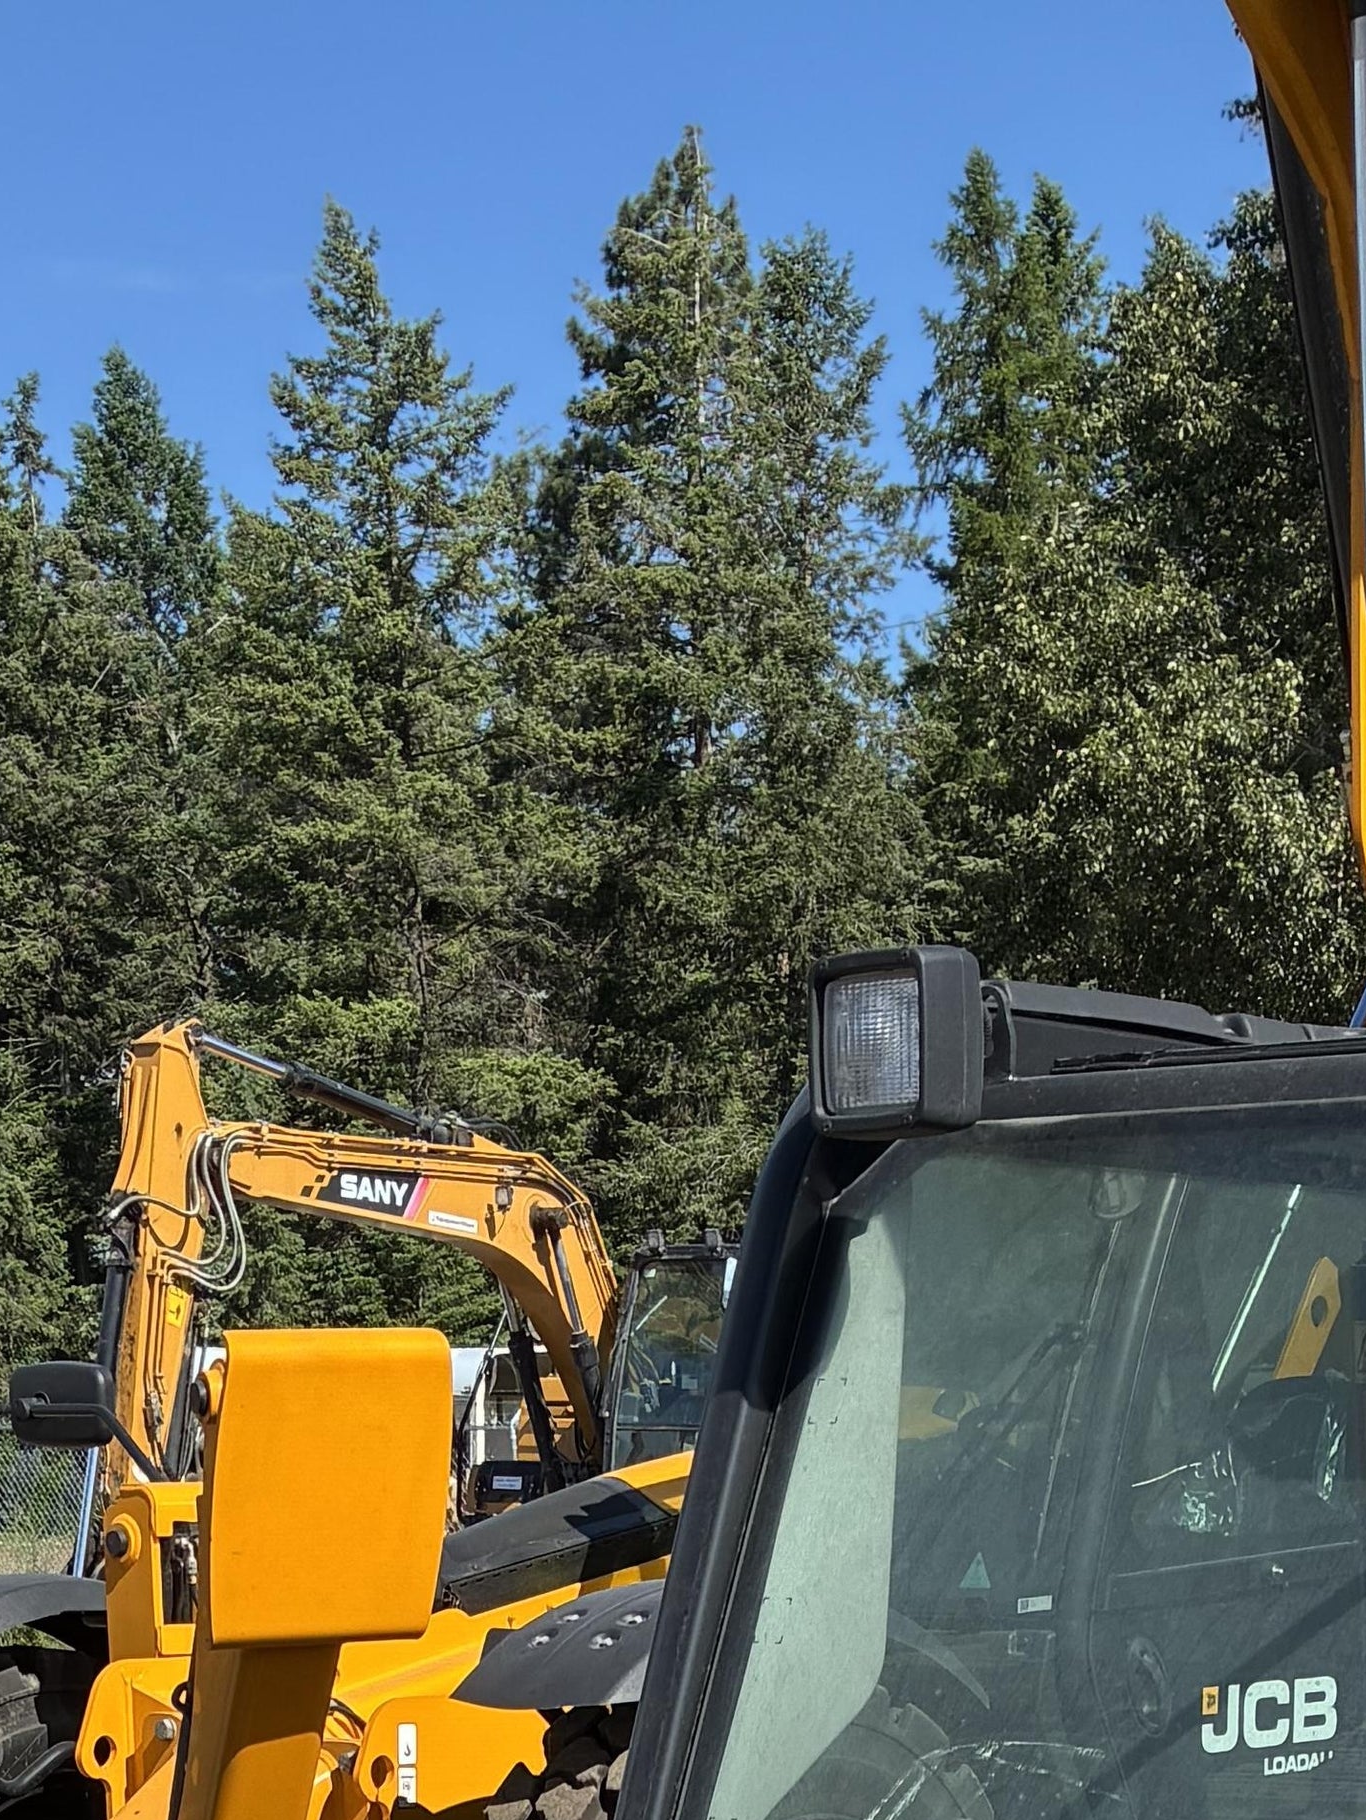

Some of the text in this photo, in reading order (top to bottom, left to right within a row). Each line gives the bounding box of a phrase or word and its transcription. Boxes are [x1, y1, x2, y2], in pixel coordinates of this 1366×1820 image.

[339, 1174, 409, 1207] SANY
[1201, 1676, 1338, 1754] JCB
[1264, 1751, 1333, 1776] LOADA
